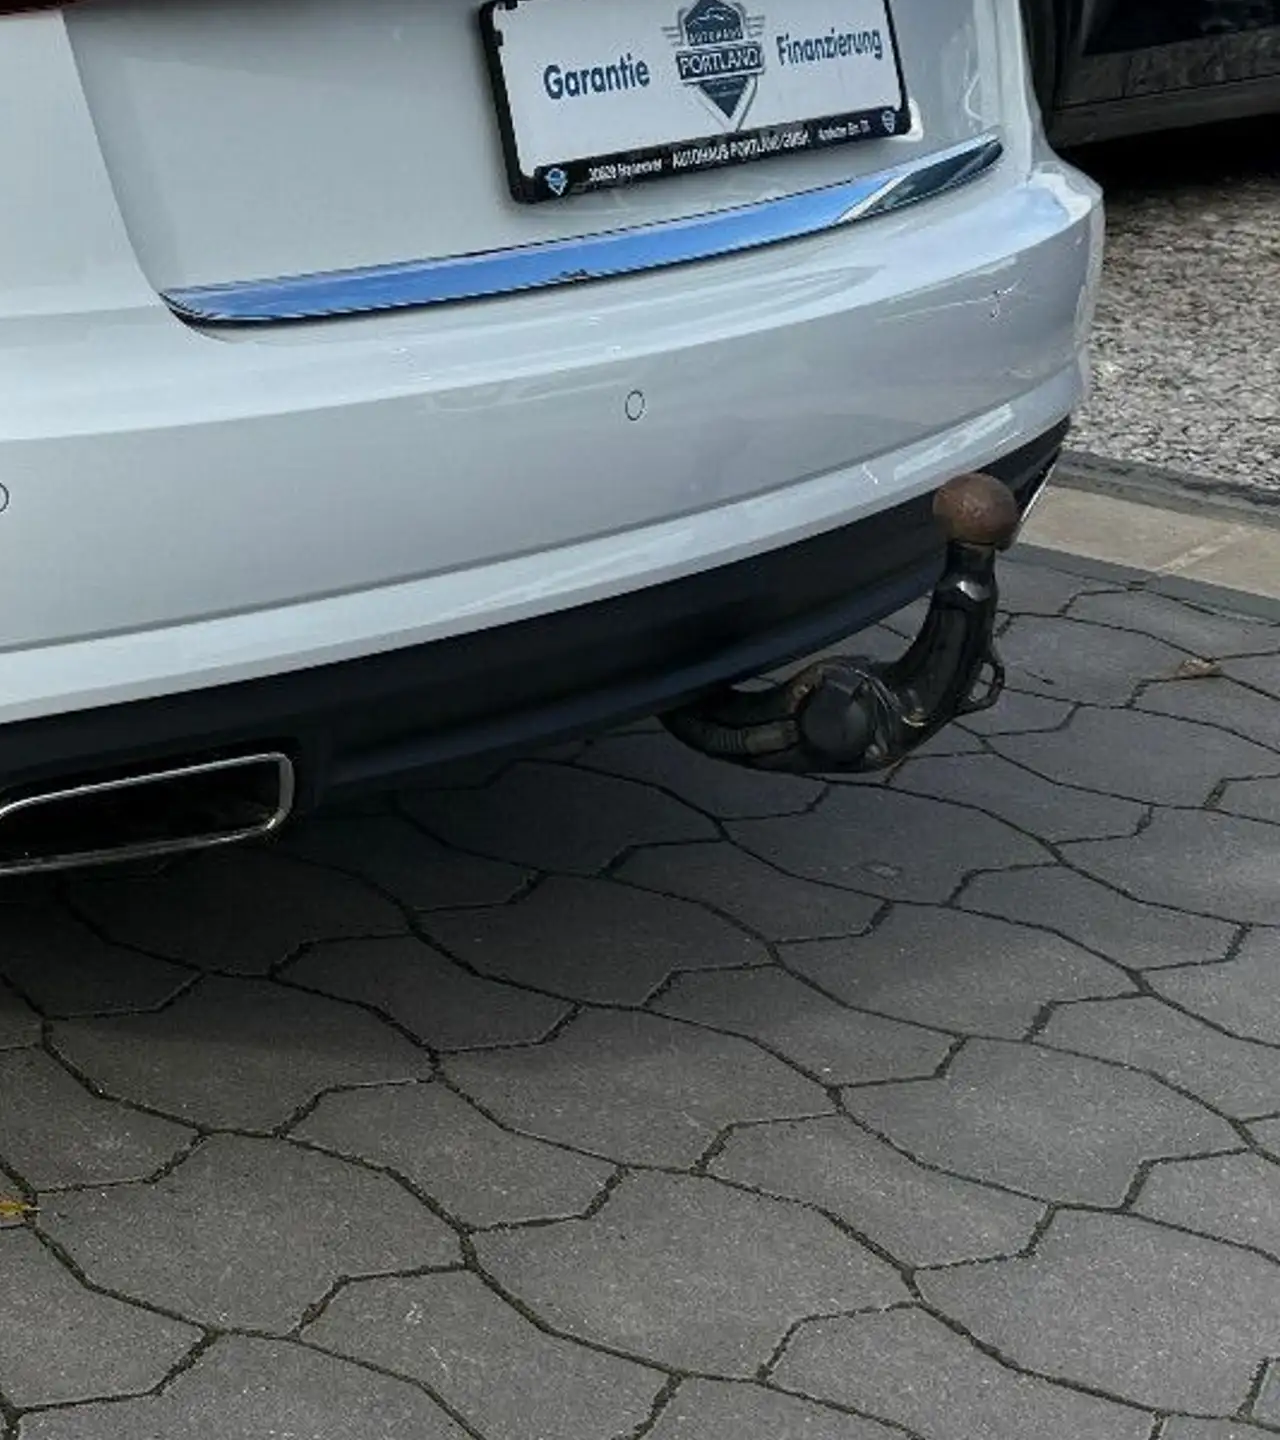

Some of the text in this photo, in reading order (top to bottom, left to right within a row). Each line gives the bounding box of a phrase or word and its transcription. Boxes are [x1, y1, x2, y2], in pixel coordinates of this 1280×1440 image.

[679, 47, 759, 76] PORTLAND
[776, 26, 883, 66] Finanzierung
[543, 52, 650, 100] Garantie
